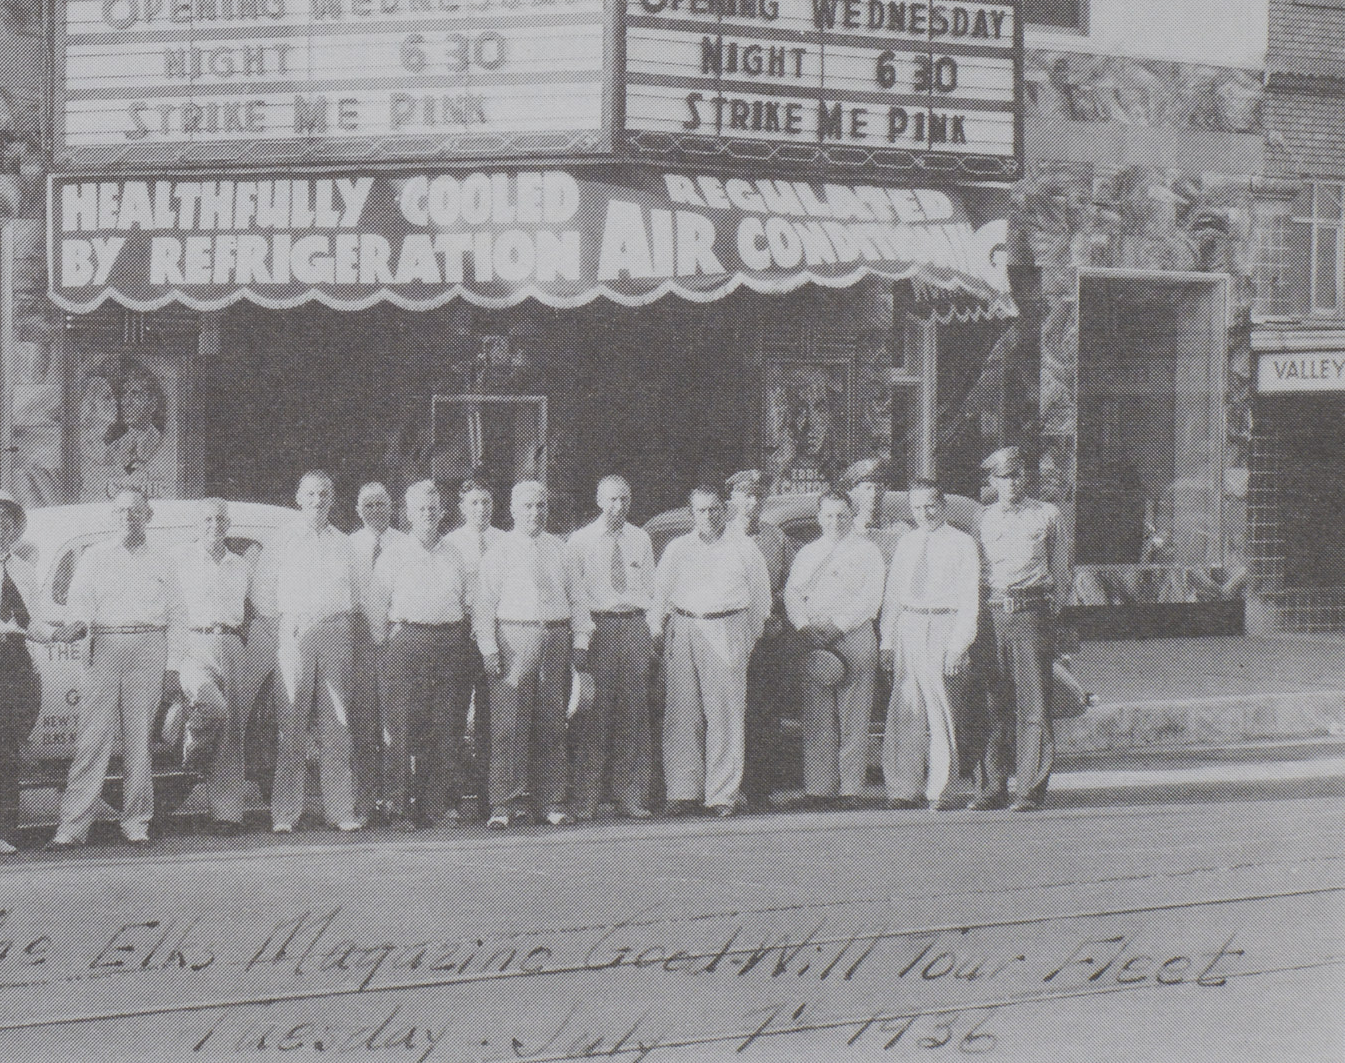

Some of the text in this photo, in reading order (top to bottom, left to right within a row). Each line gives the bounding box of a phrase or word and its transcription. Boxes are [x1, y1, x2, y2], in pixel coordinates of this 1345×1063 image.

[164, 43, 294, 80] NIGHT
[701, 36, 808, 81] NIGHT
[125, 91, 488, 141] STRIKE ME PINK
[682, 92, 967, 145] STRIKE ME PINK
[62, 171, 580, 231] HEALTHFULLY COOLED
[663, 173, 954, 223] REGULATED
[62, 229, 581, 287] BY REFRIGERATION
[597, 199, 727, 282] AIR
[1273, 359, 1345, 380] VALLEY
[45, 642, 81, 661] THE
